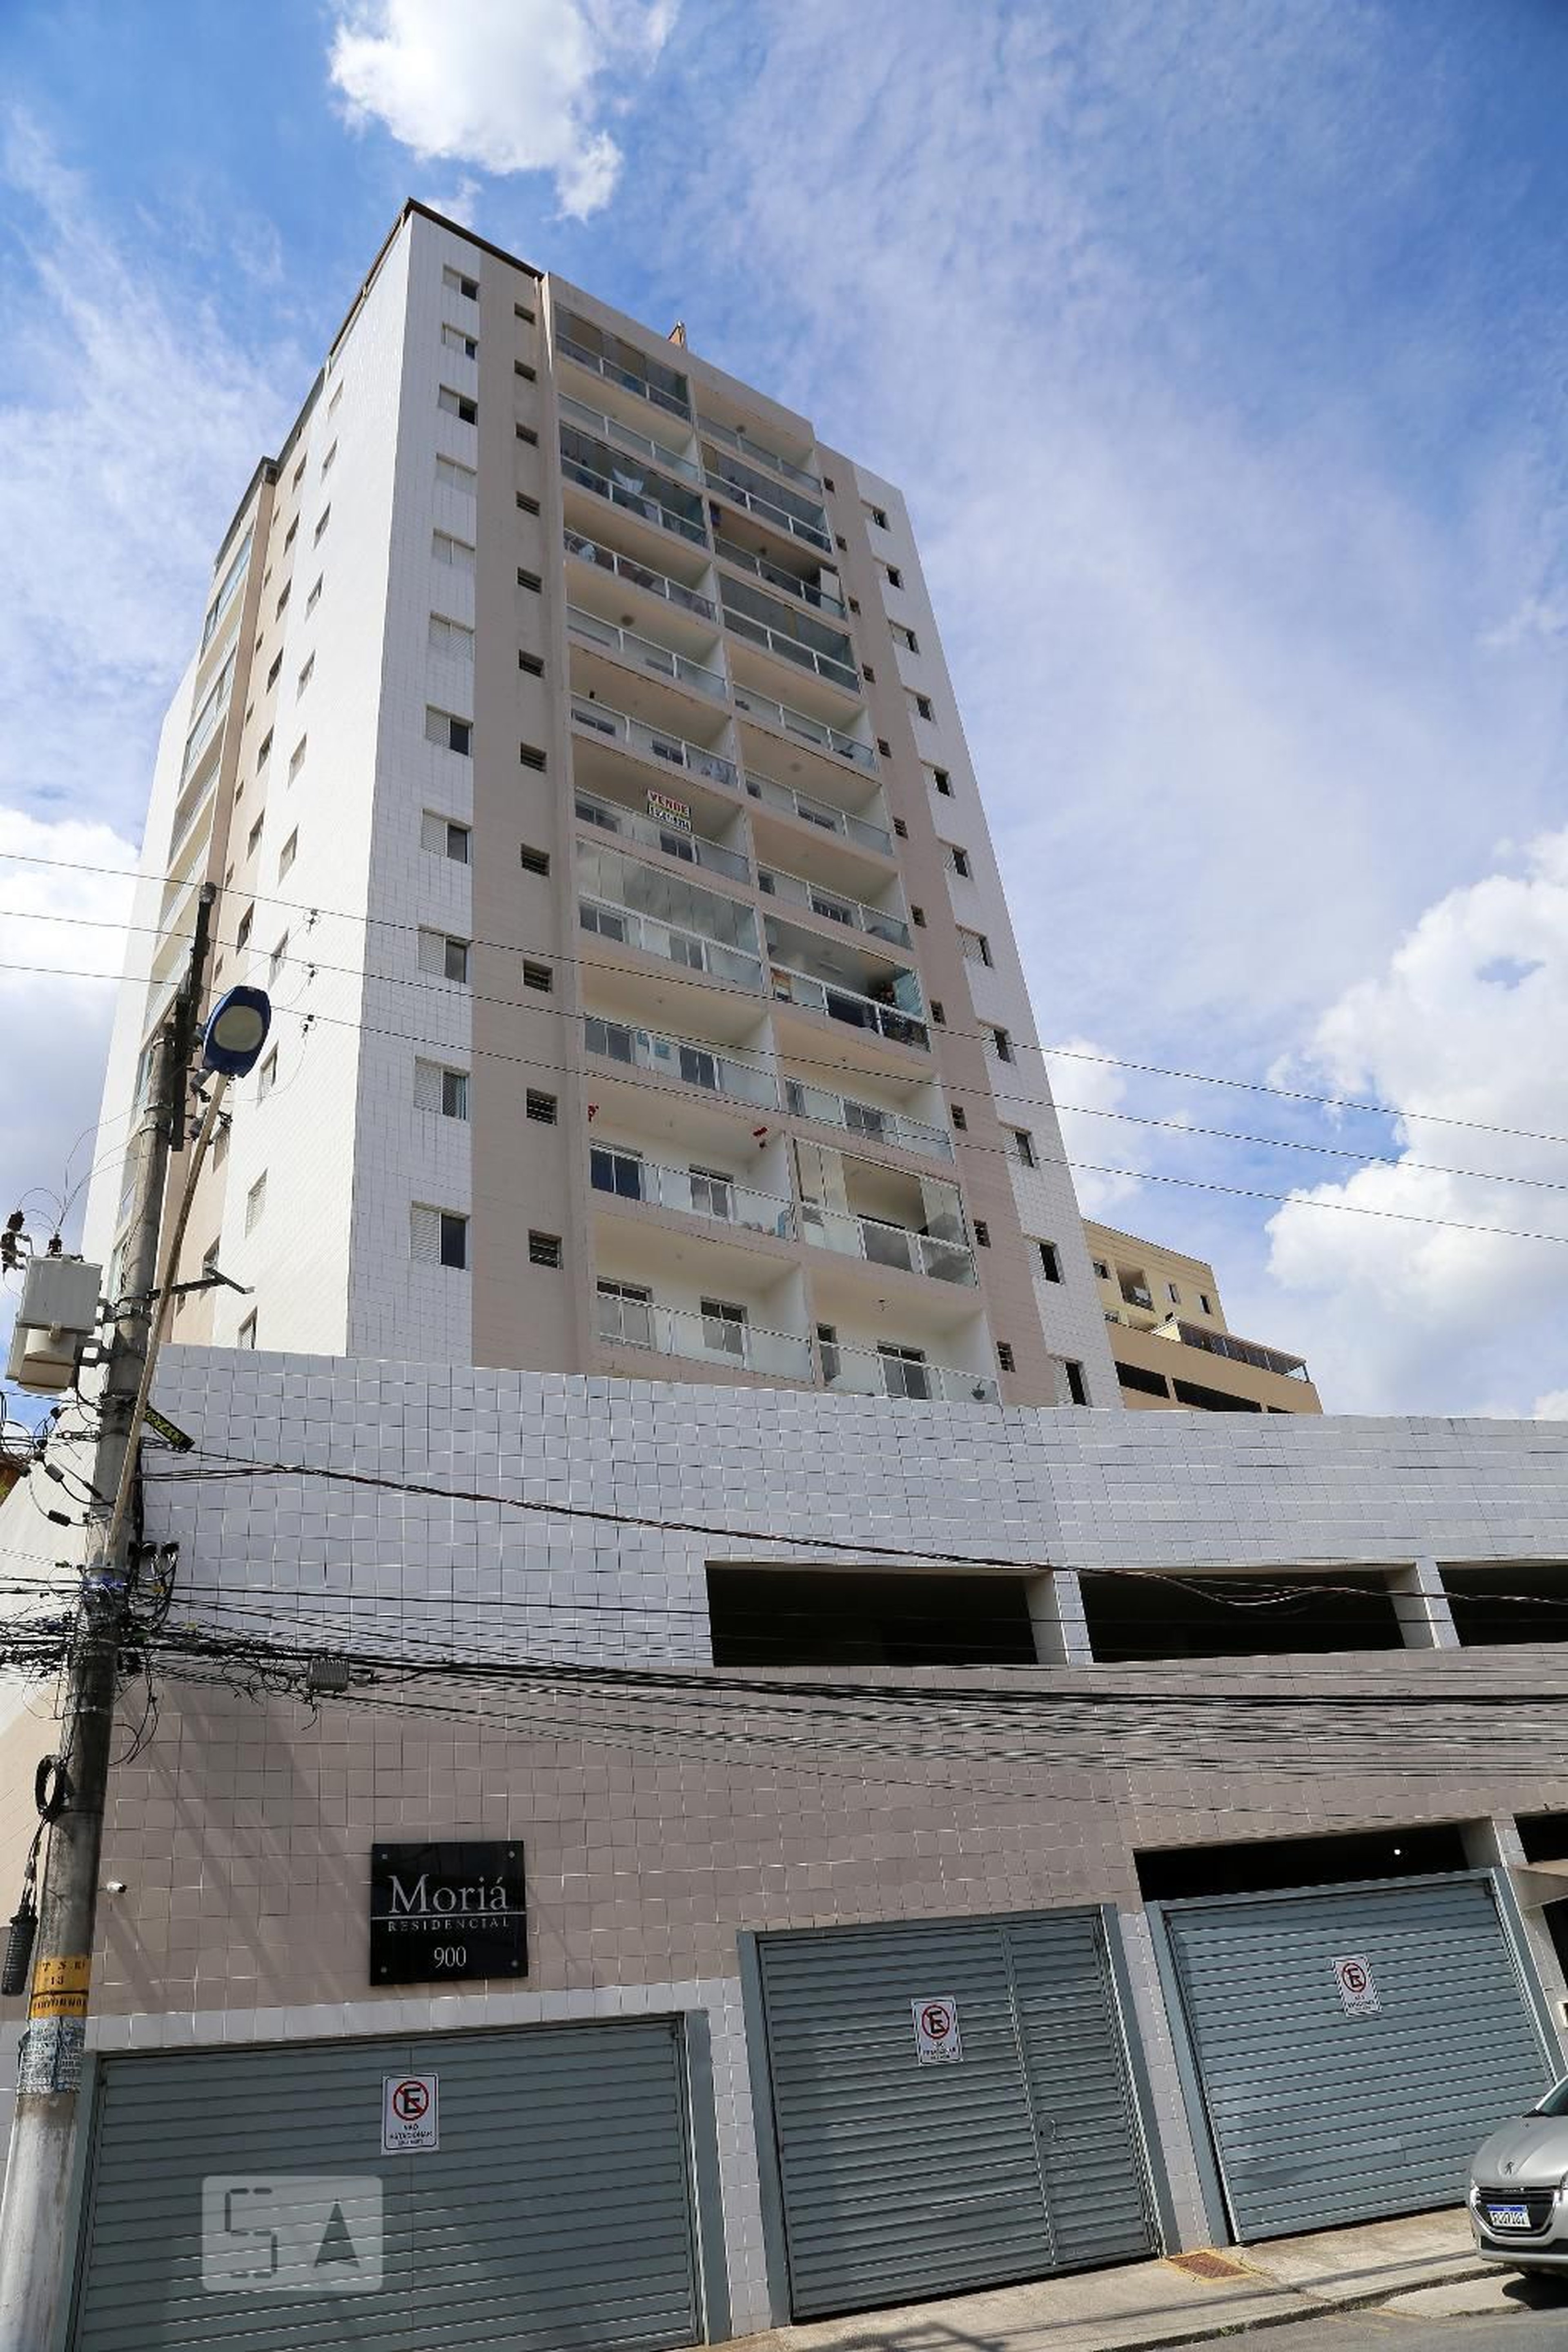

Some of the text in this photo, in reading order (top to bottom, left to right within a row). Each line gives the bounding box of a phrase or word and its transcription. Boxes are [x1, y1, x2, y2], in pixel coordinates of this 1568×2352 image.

[650, 792, 688, 814] VENDE
[388, 1874, 510, 1913] Moriá
[388, 1918, 509, 1932] RESIDENCIAL
[434, 1946, 466, 1968] 900
